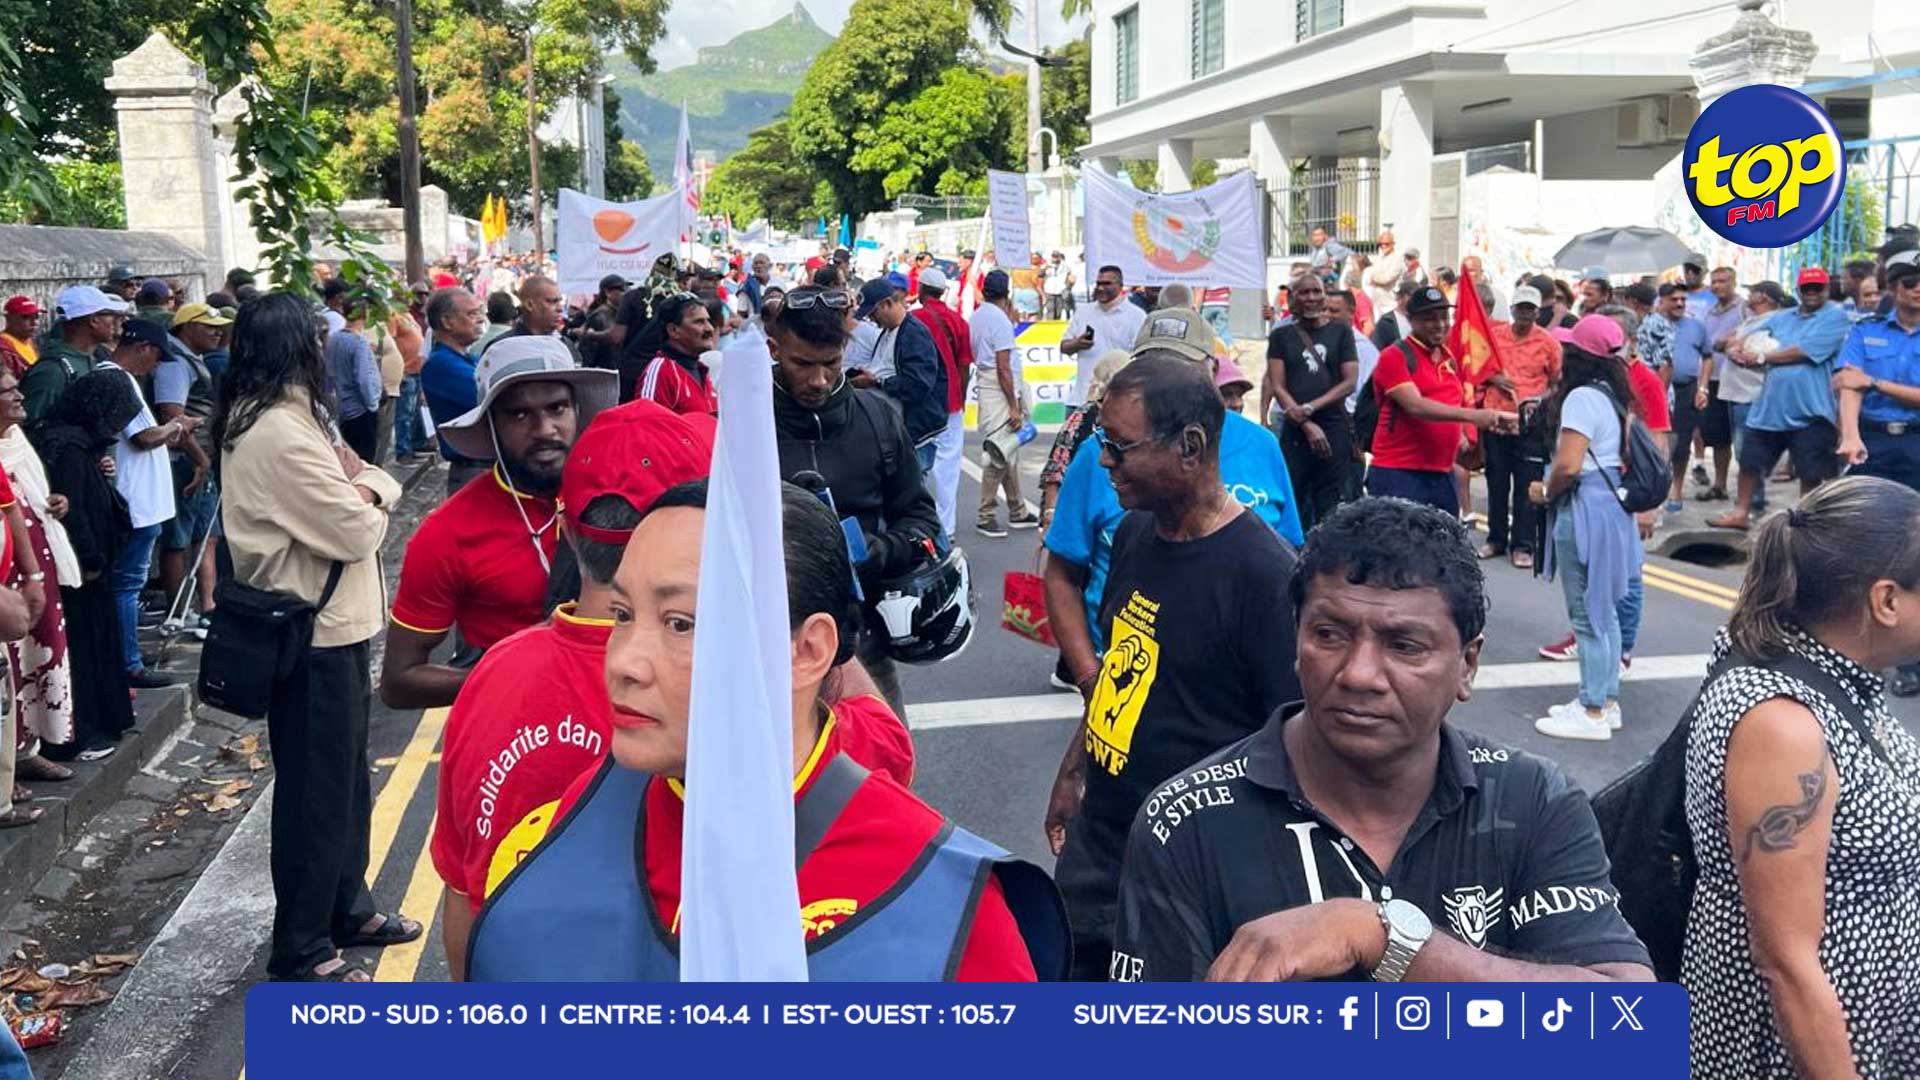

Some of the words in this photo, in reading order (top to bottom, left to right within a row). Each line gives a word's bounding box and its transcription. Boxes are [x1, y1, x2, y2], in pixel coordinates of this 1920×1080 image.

[1131, 590, 1161, 613] General
[557, 714, 602, 755] dan
[1086, 727, 1128, 776] GWF
[1165, 786, 1235, 827] STYLE
